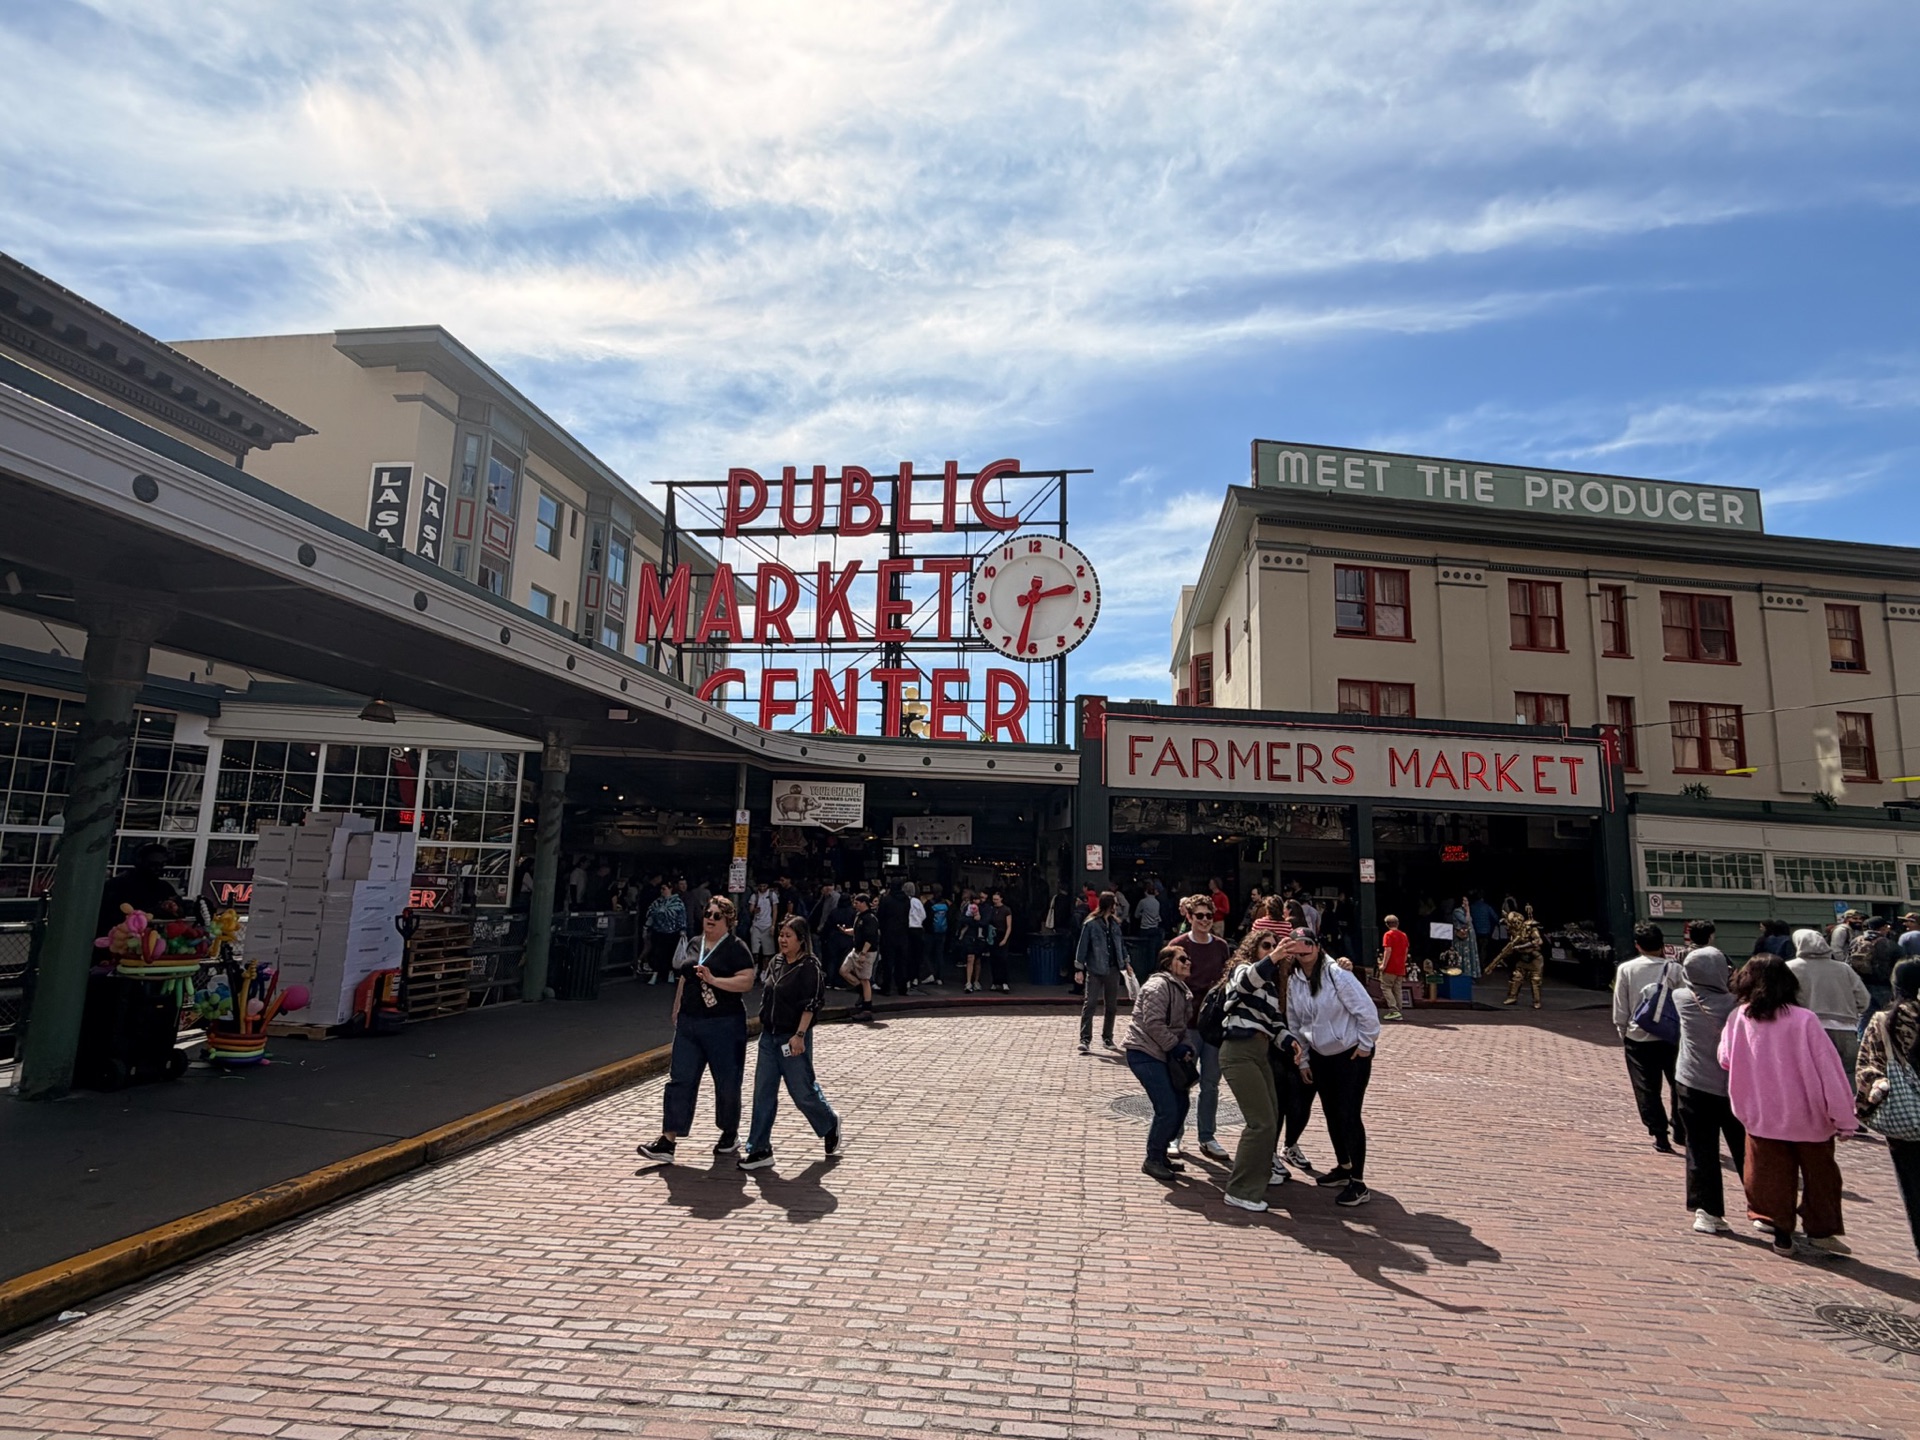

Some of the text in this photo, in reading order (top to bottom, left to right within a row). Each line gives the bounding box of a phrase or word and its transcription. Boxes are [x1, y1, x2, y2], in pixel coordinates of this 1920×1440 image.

[1278, 450, 1745, 525] MEET THE PRODUCER
[724, 458, 1021, 537] PUBLIC
[375, 472, 402, 543] LASA
[420, 482, 441, 559] LASA
[1029, 541, 1041, 553] 12
[1059, 547, 1063, 559] 1
[1004, 547, 1013, 560] 11
[984, 566, 996, 578] 10
[1076, 566, 1085, 577] 2
[635, 559, 971, 644] MARKET
[977, 592, 986, 603] 9
[1083, 591, 1091, 603] 3
[983, 617, 992, 629] 8
[1073, 616, 1084, 628] 4
[1003, 636, 1012, 648] 7
[1057, 636, 1065, 647] 5
[1028, 643, 1037, 654] 6
[1128, 734, 1584, 795] FARMERS MARKET
[810, 786, 862, 797] YOUR CHANGE
